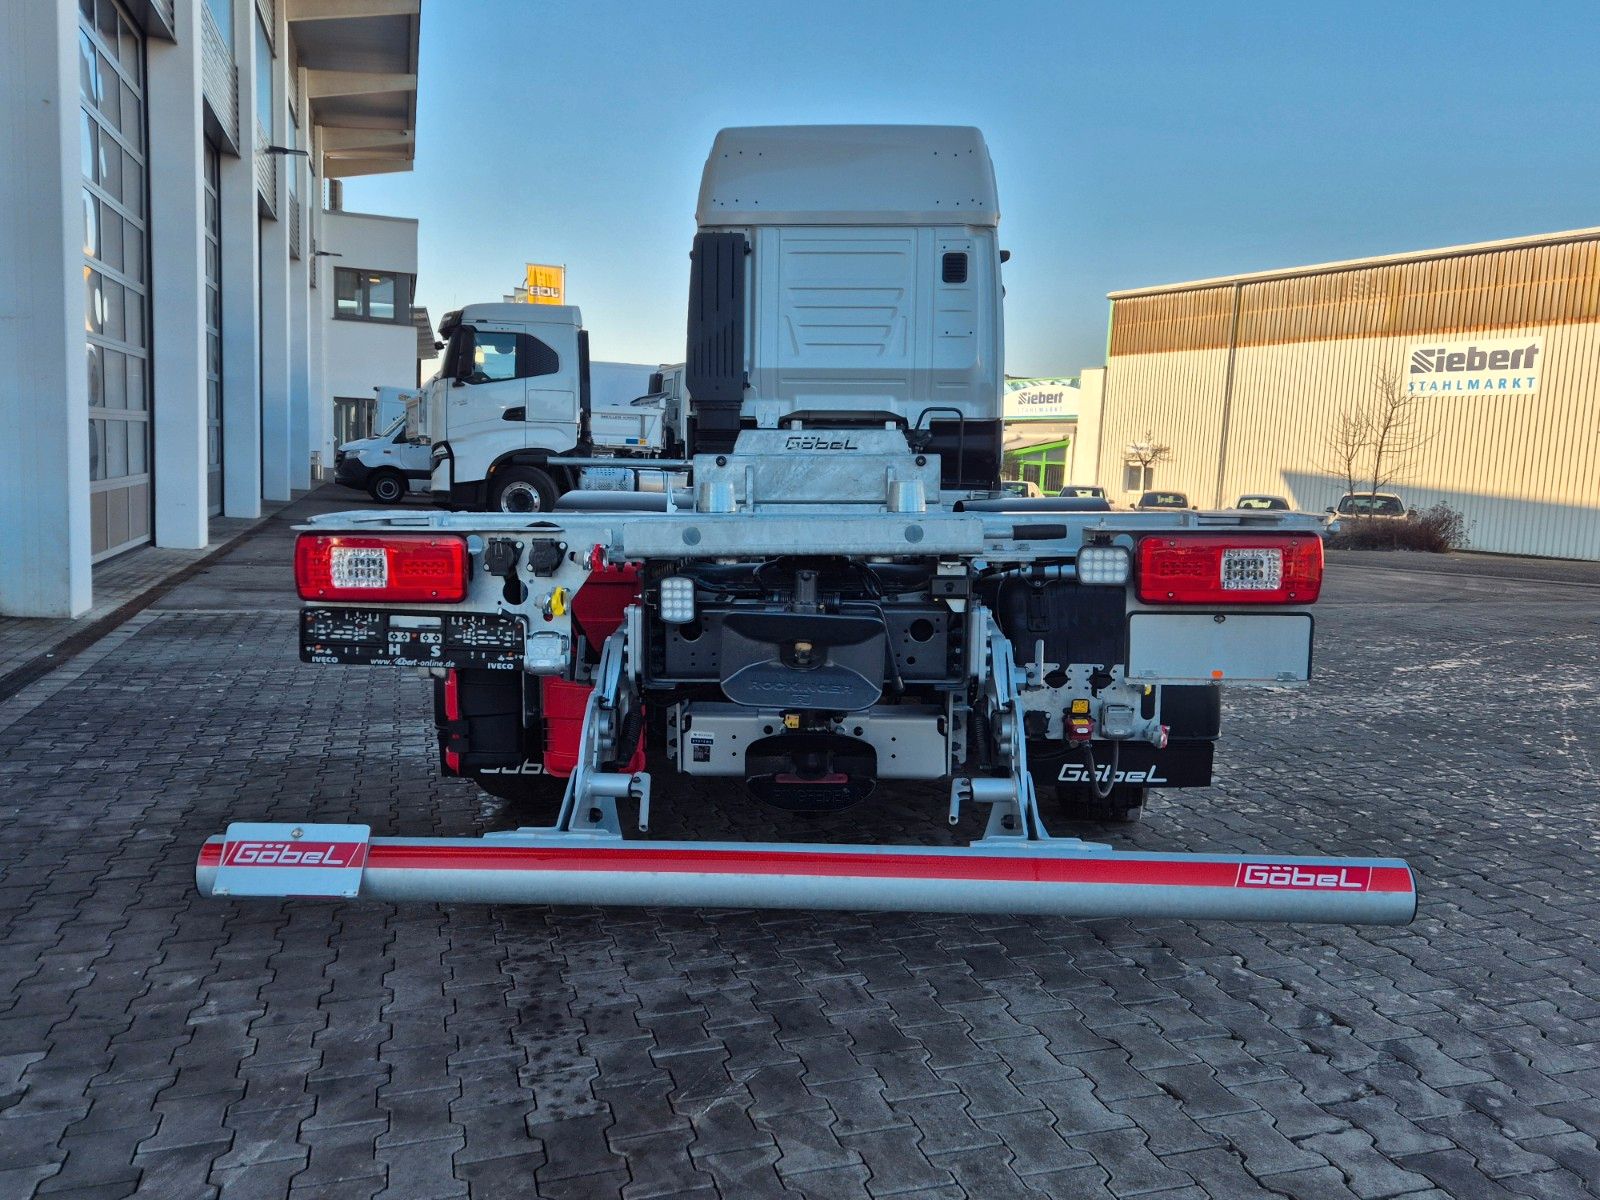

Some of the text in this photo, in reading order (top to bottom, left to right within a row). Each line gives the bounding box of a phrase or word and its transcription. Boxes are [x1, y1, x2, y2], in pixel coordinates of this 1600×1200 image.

[1410, 343, 1540, 374] Siebert
[1408, 376, 1536, 392] STAHLMARKT
[1018, 391, 1064, 405] Siebert
[311, 656, 339, 664] IVECO
[487, 662, 514, 670] IVECO
